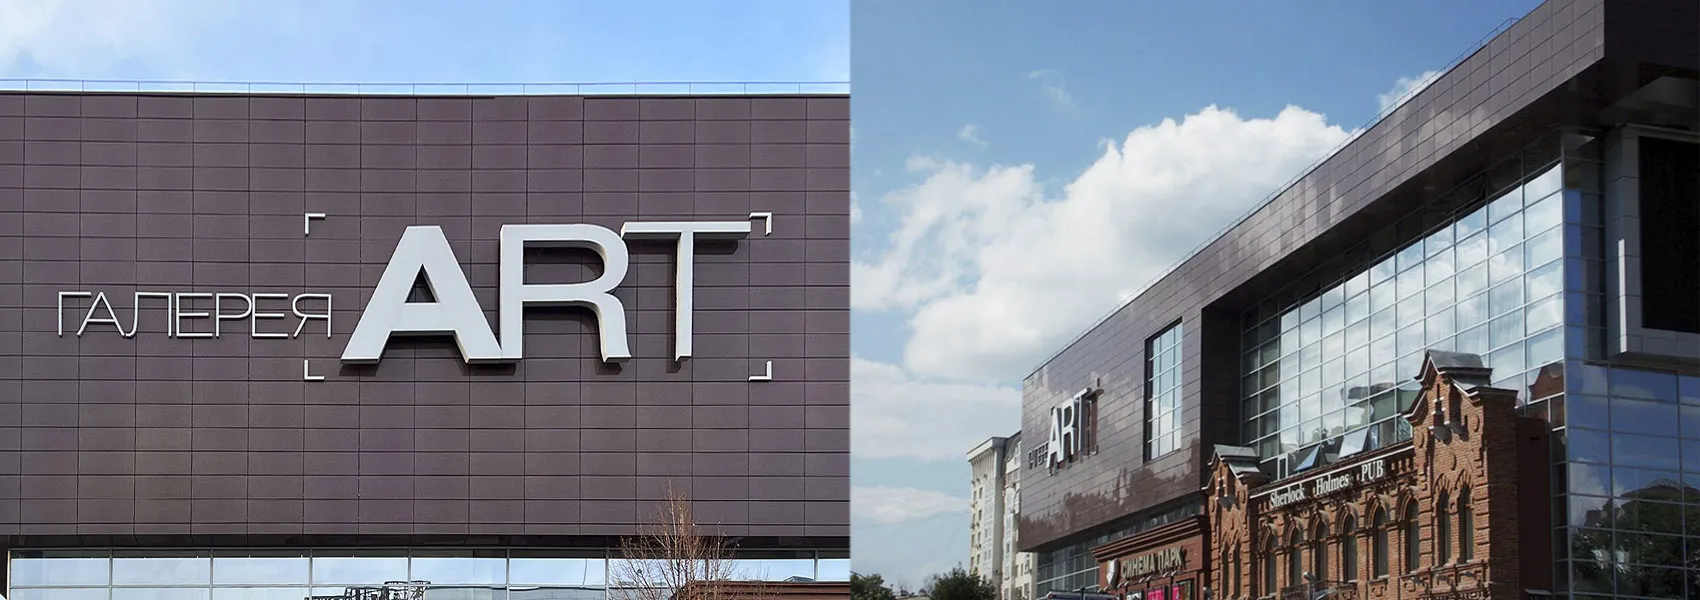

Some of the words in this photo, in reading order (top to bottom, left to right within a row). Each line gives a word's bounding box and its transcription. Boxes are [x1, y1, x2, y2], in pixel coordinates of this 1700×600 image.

[58, 292, 332, 338] ГАЛЕРЕЯ
[340, 222, 751, 363] ART
[1045, 387, 1089, 468] ART
[1270, 483, 1305, 508] Sherlock
[1316, 473, 1350, 495] Holmes
[1361, 460, 1384, 482] PUB
[1121, 554, 1155, 579] СИНЕМА
[1158, 545, 1182, 569] ПАРК
